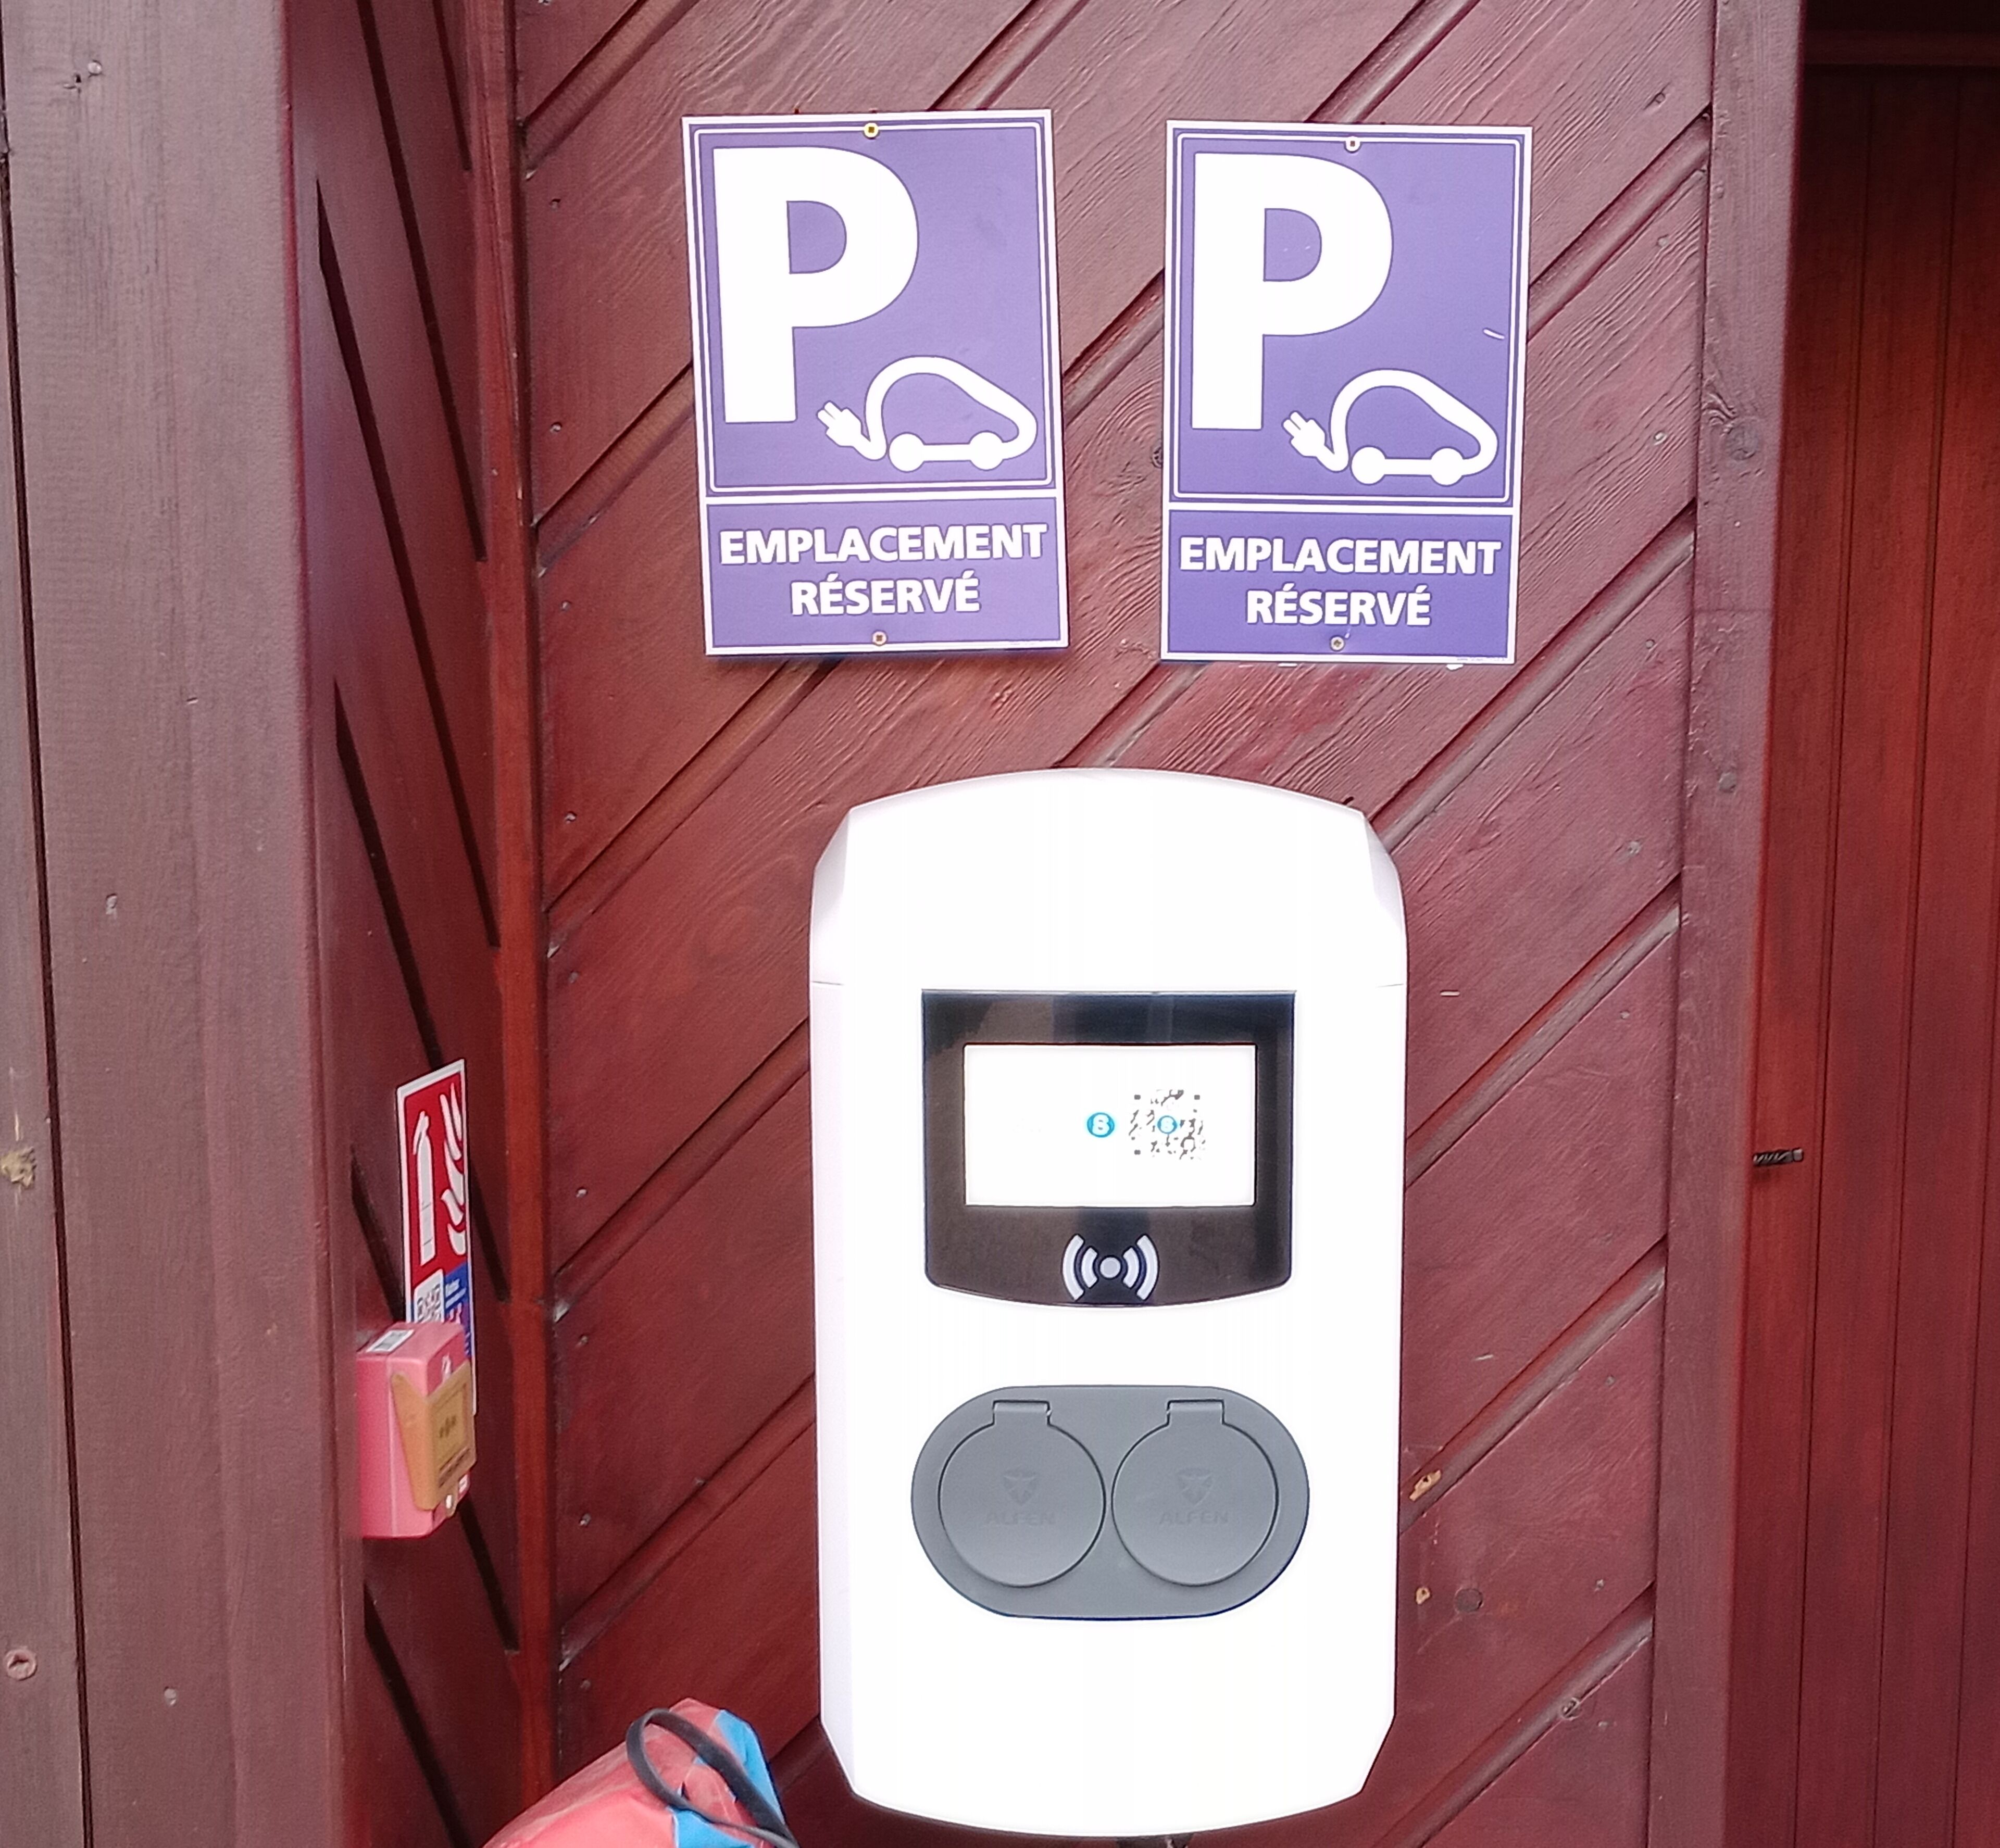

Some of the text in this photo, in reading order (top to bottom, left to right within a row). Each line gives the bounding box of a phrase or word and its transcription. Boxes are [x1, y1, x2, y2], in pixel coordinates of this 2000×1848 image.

[714, 147, 919, 424] P
[1192, 153, 1393, 429] P
[720, 524, 1047, 564] EMPLACEMENT
[1180, 537, 1501, 574] EMPLACEMENT
[792, 570, 980, 615] RÉSERVÉ
[1247, 583, 1431, 625] RÉSERVÉ
[985, 1511, 1056, 1526] ALFEN
[1159, 1511, 1228, 1525] ALFEN
